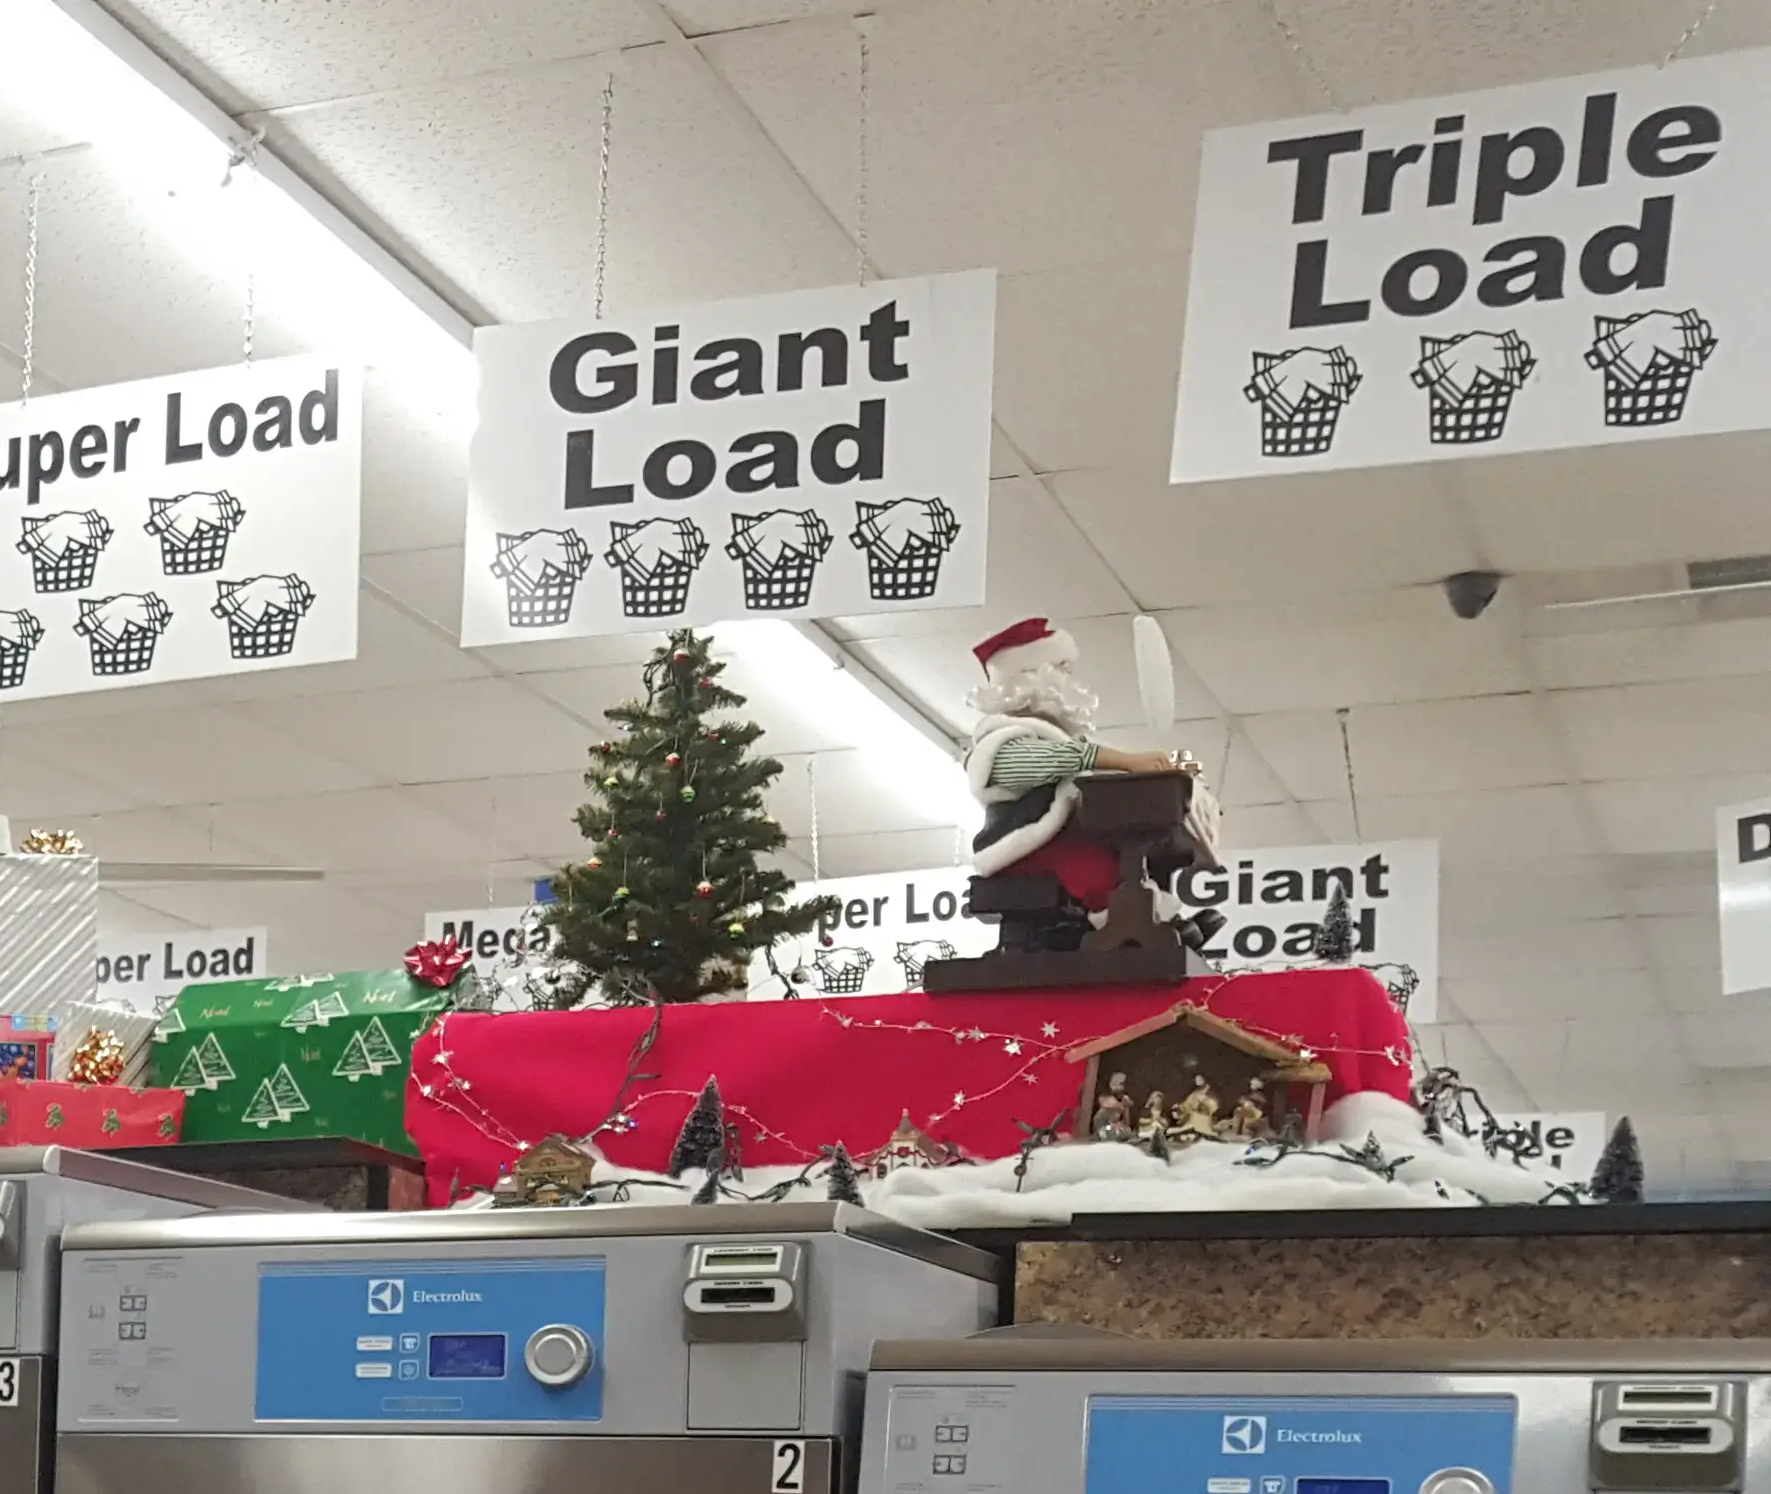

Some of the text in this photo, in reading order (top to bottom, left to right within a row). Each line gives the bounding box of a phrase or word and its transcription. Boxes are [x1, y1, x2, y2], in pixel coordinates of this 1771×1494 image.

[1267, 92, 1723, 226] Triple
[1289, 195, 1675, 329] Load
[548, 298, 911, 416] Giant
[165, 369, 340, 463] Load
[564, 397, 887, 511] Load
[1177, 853, 1389, 907] Giant
[163, 937, 255, 980] Load
[412, 1288, 483, 1305] Electrolux
[775, 1443, 801, 1490] 2
[1276, 1427, 1363, 1447] Electrolux
